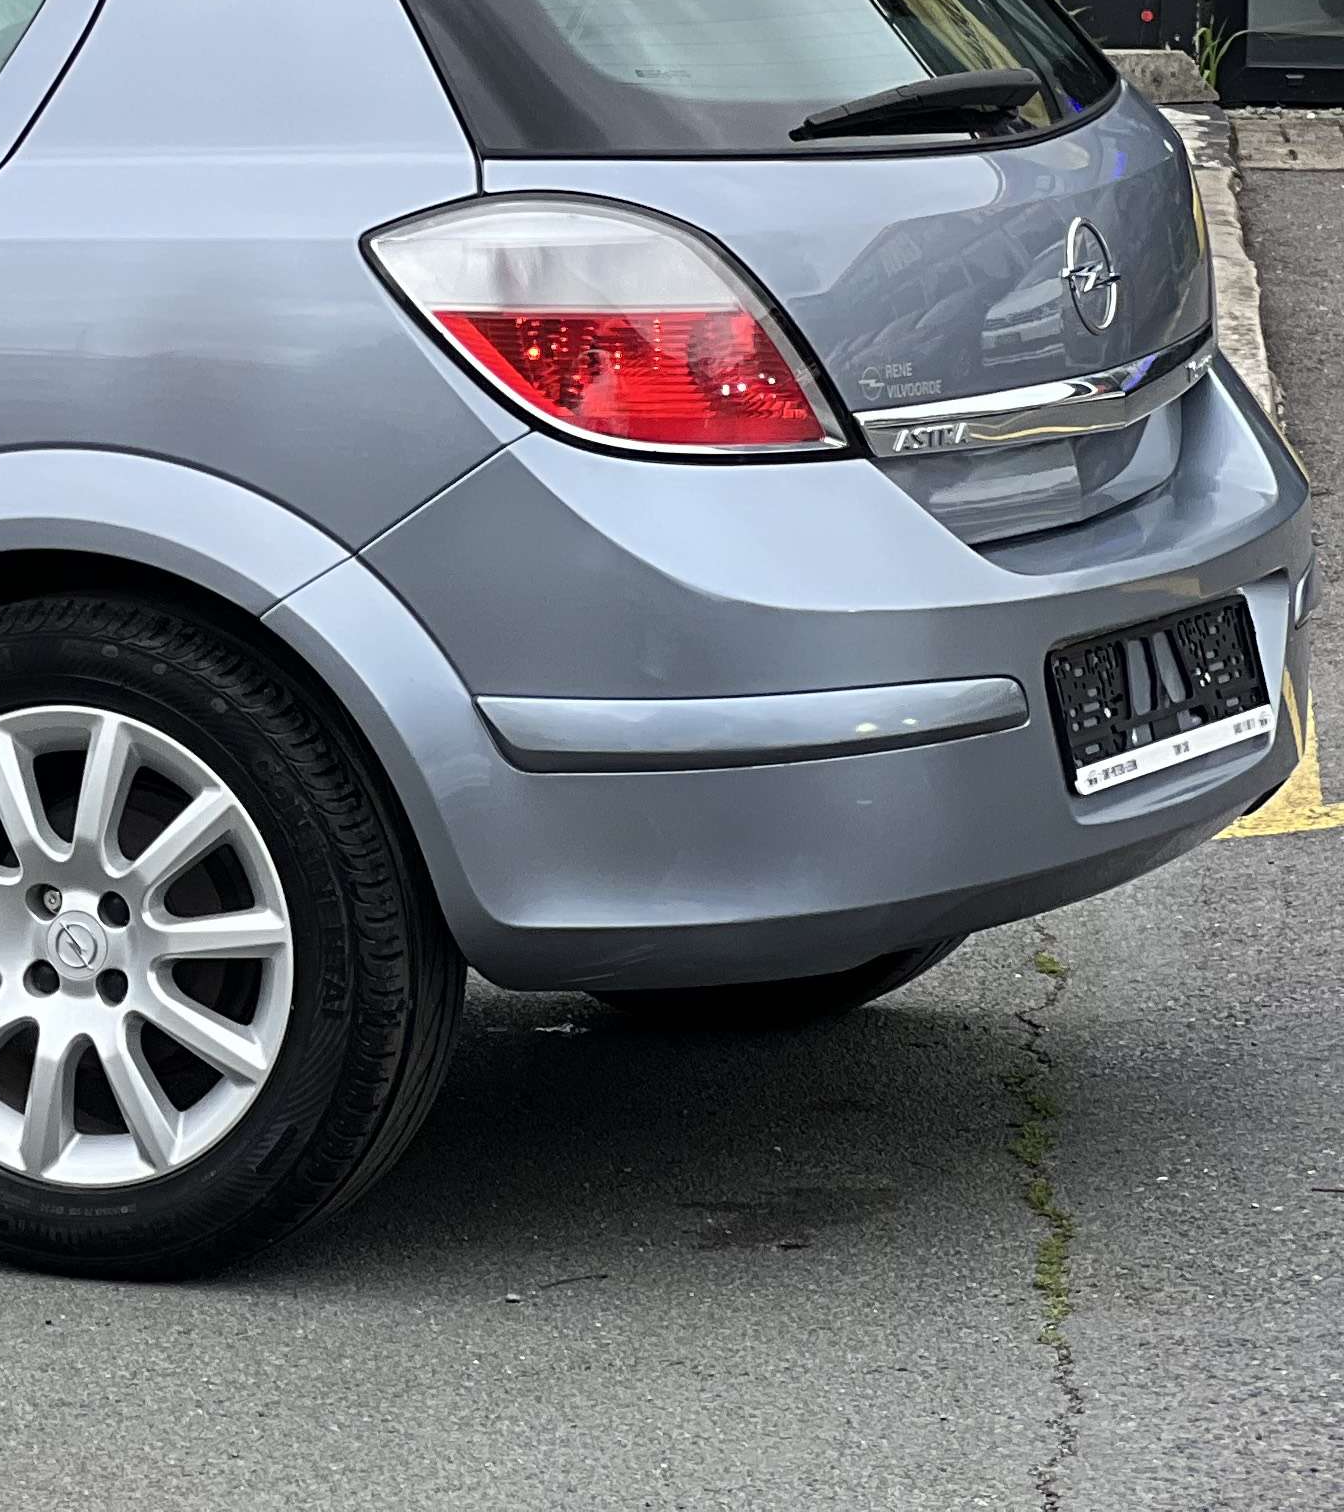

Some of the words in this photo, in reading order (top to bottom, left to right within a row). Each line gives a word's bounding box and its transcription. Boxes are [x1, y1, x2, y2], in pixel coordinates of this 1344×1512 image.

[885, 362, 913, 379] RENE
[887, 379, 943, 399] VILVOORDE
[892, 422, 968, 453] ASTRA
